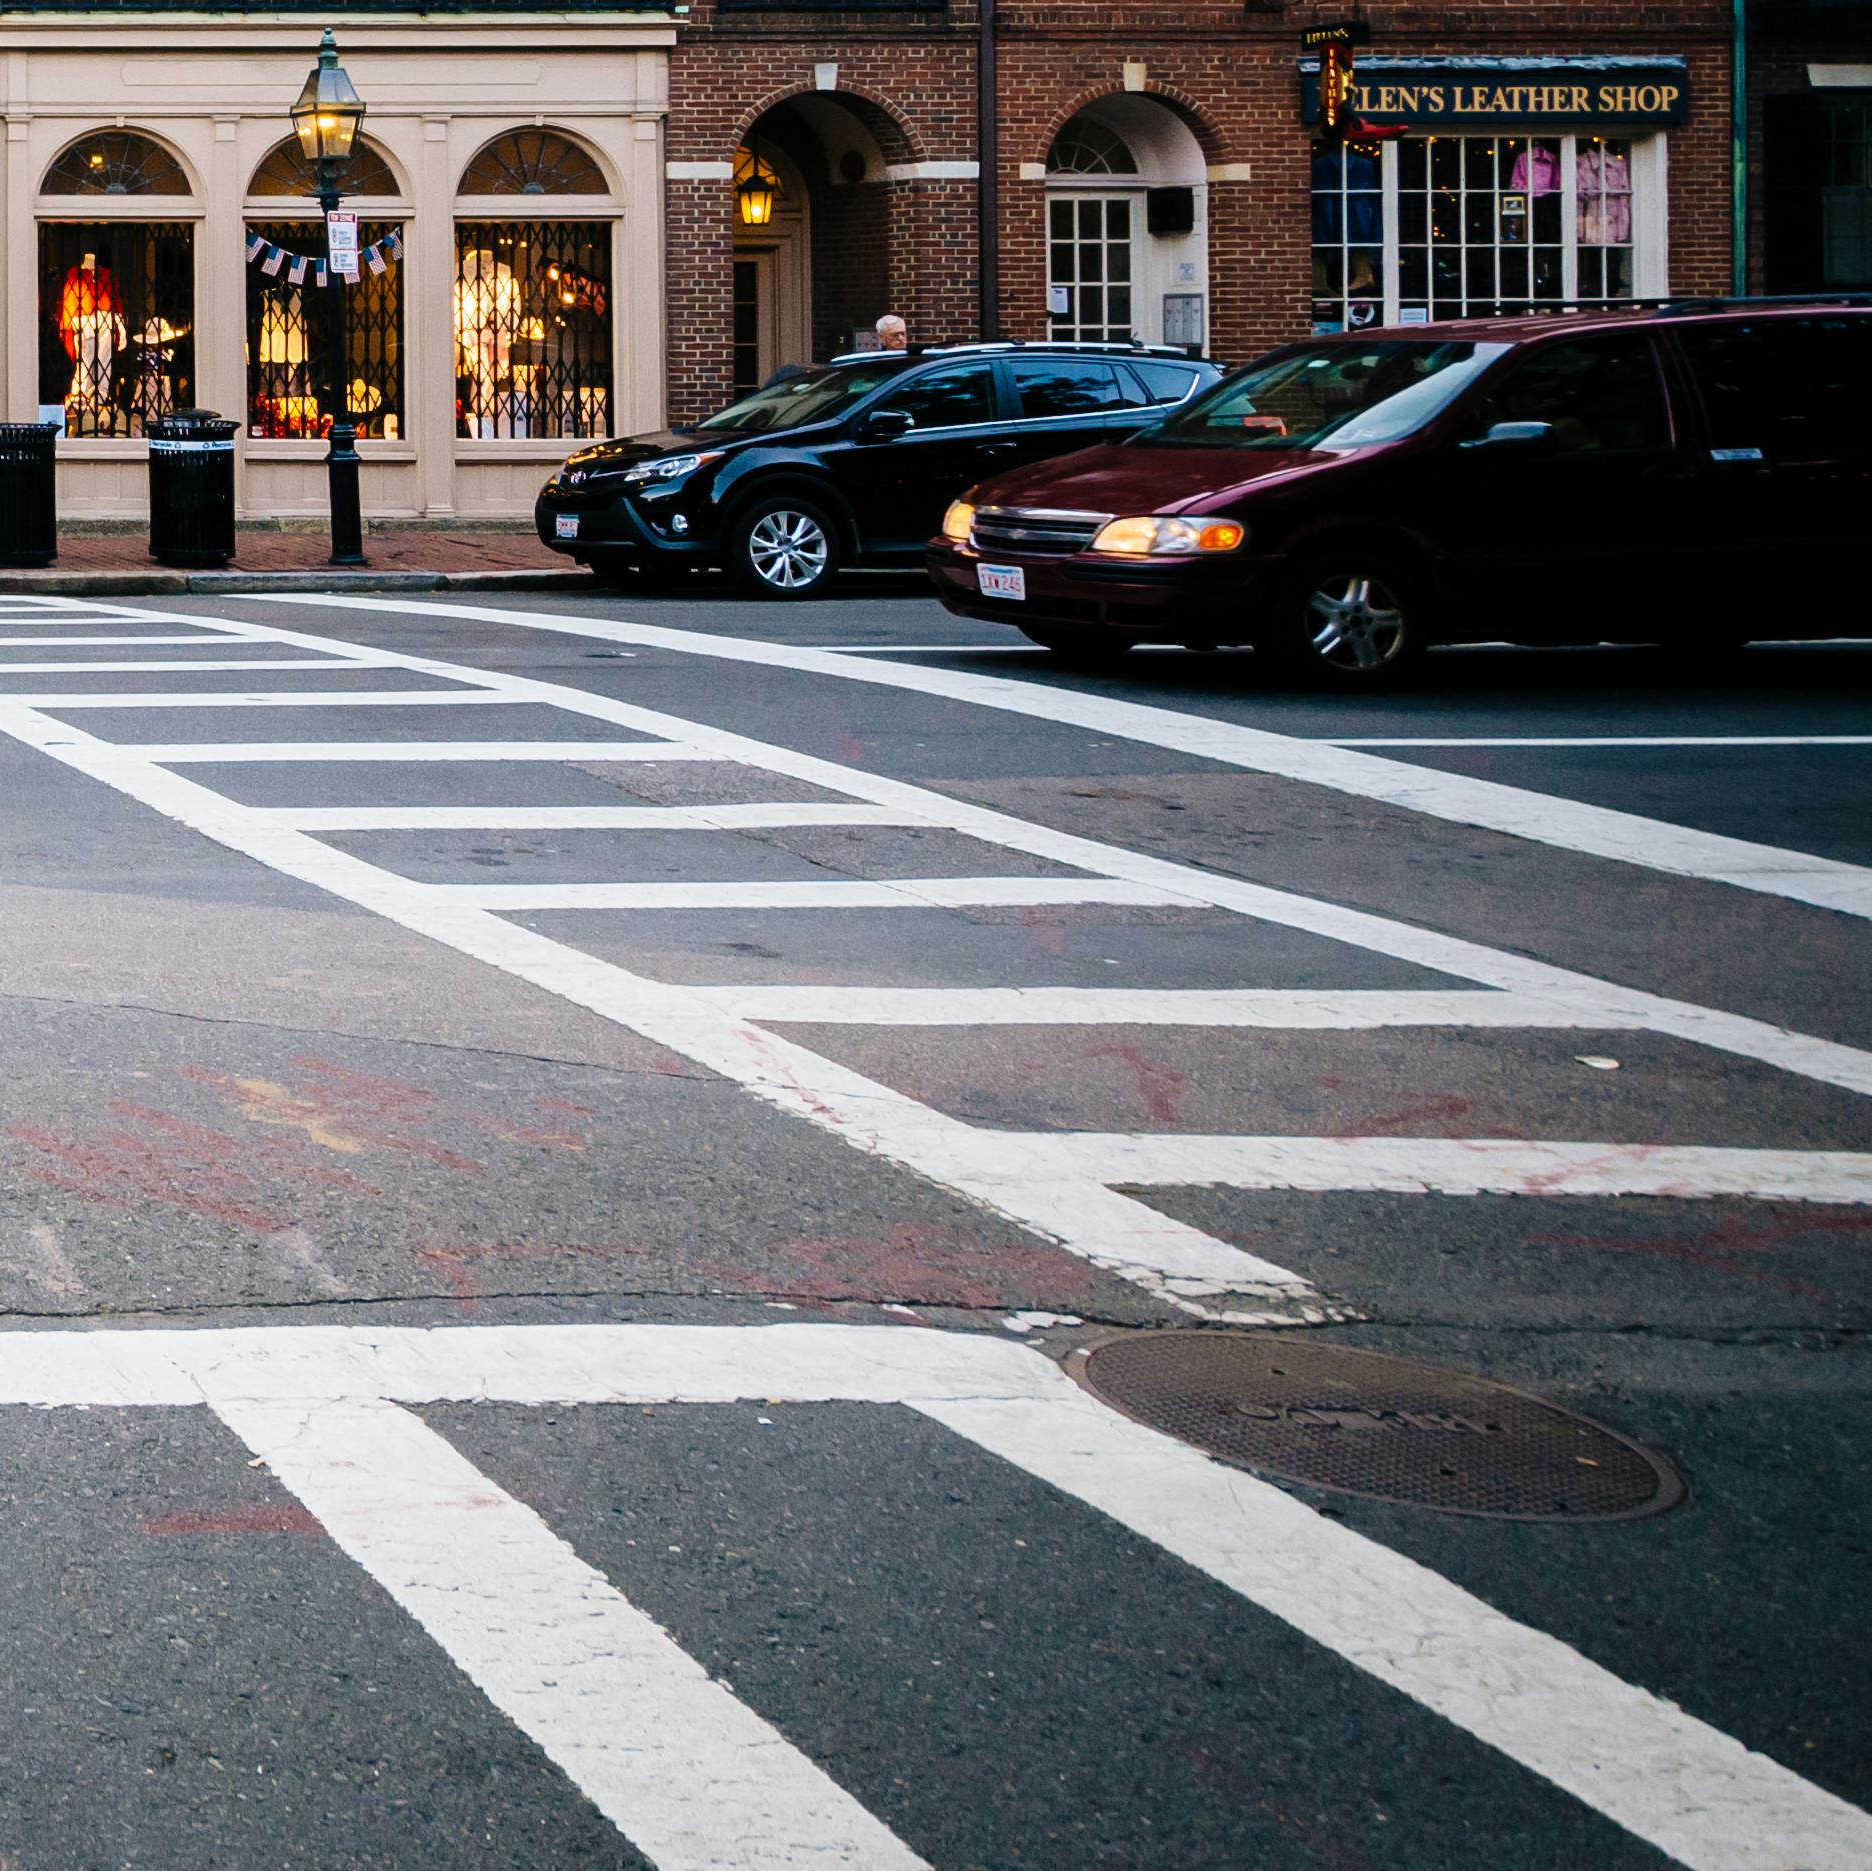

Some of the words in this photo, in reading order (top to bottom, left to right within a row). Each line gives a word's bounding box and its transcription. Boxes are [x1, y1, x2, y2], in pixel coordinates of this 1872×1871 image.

[1349, 85, 1445, 113] LEN'S
[1452, 85, 1593, 113] LEATHER
[1598, 85, 1679, 113] SHOP
